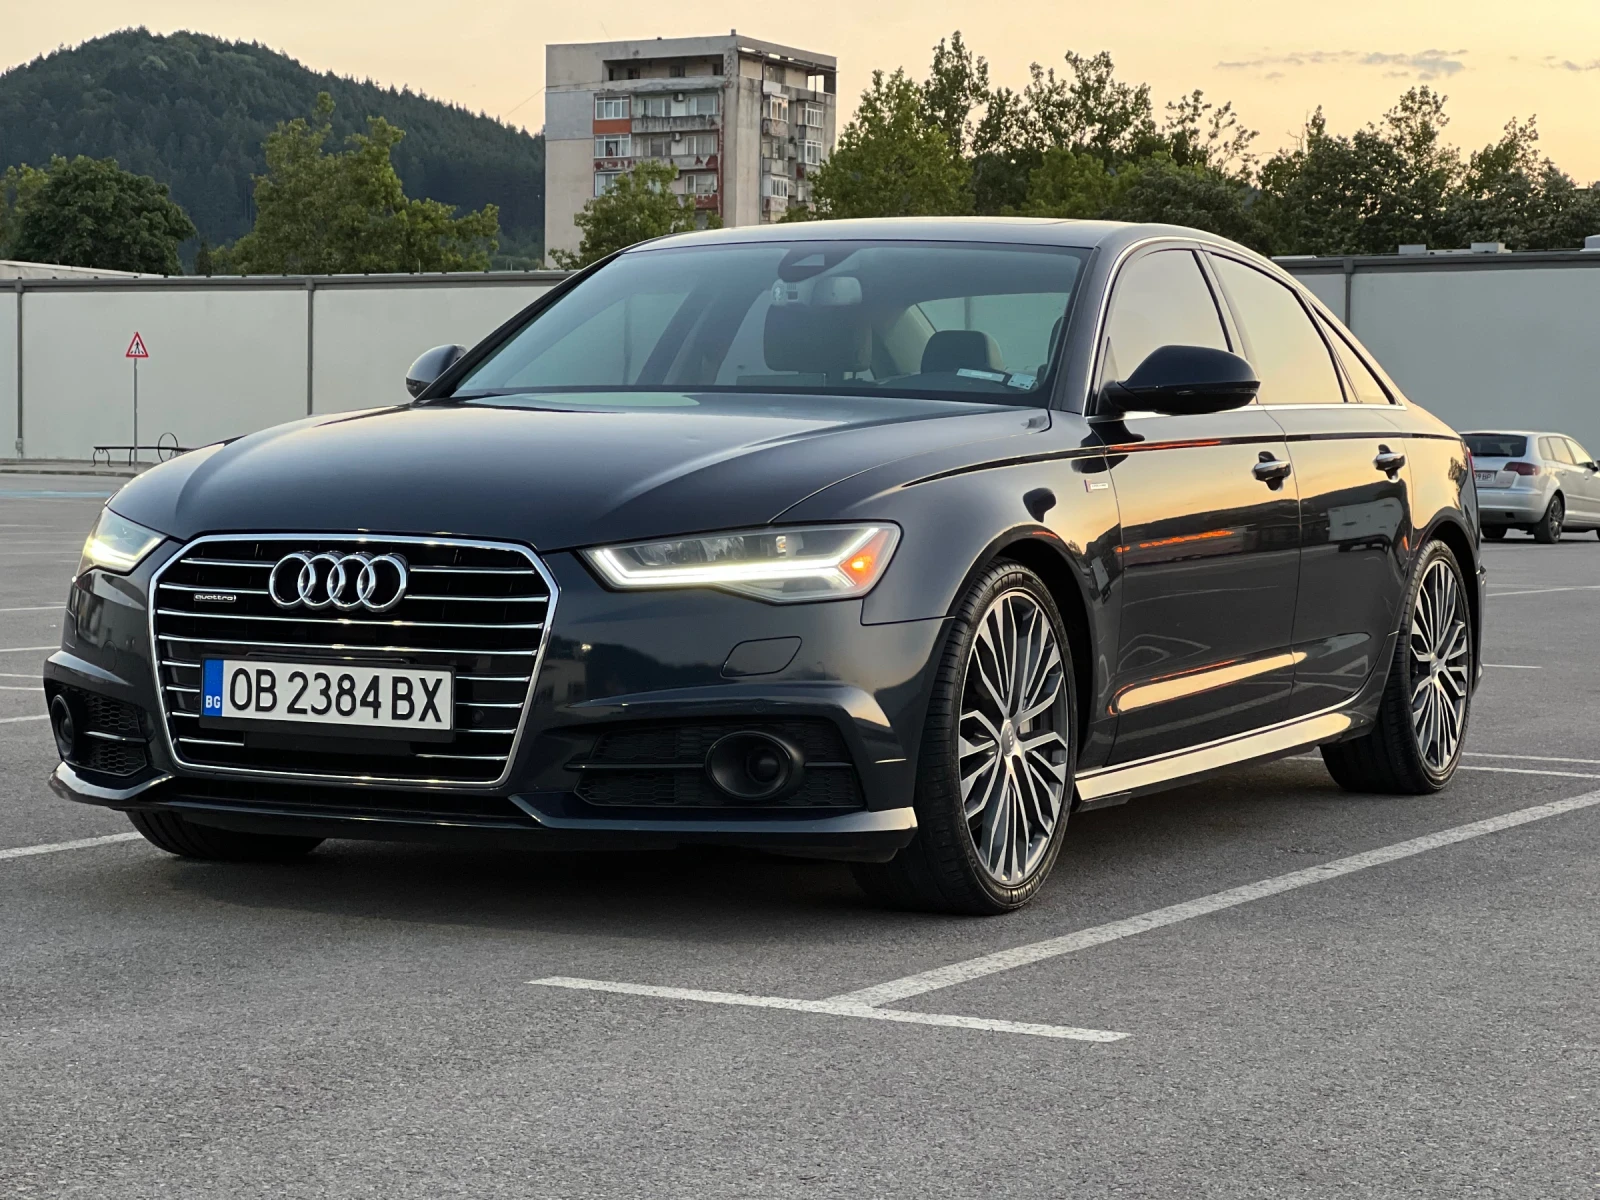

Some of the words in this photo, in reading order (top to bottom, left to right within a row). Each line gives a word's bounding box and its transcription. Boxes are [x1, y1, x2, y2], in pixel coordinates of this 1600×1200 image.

[205, 695, 221, 709] BG
[229, 667, 278, 712] OB
[287, 671, 382, 719] 2384
[391, 676, 443, 723] BX
